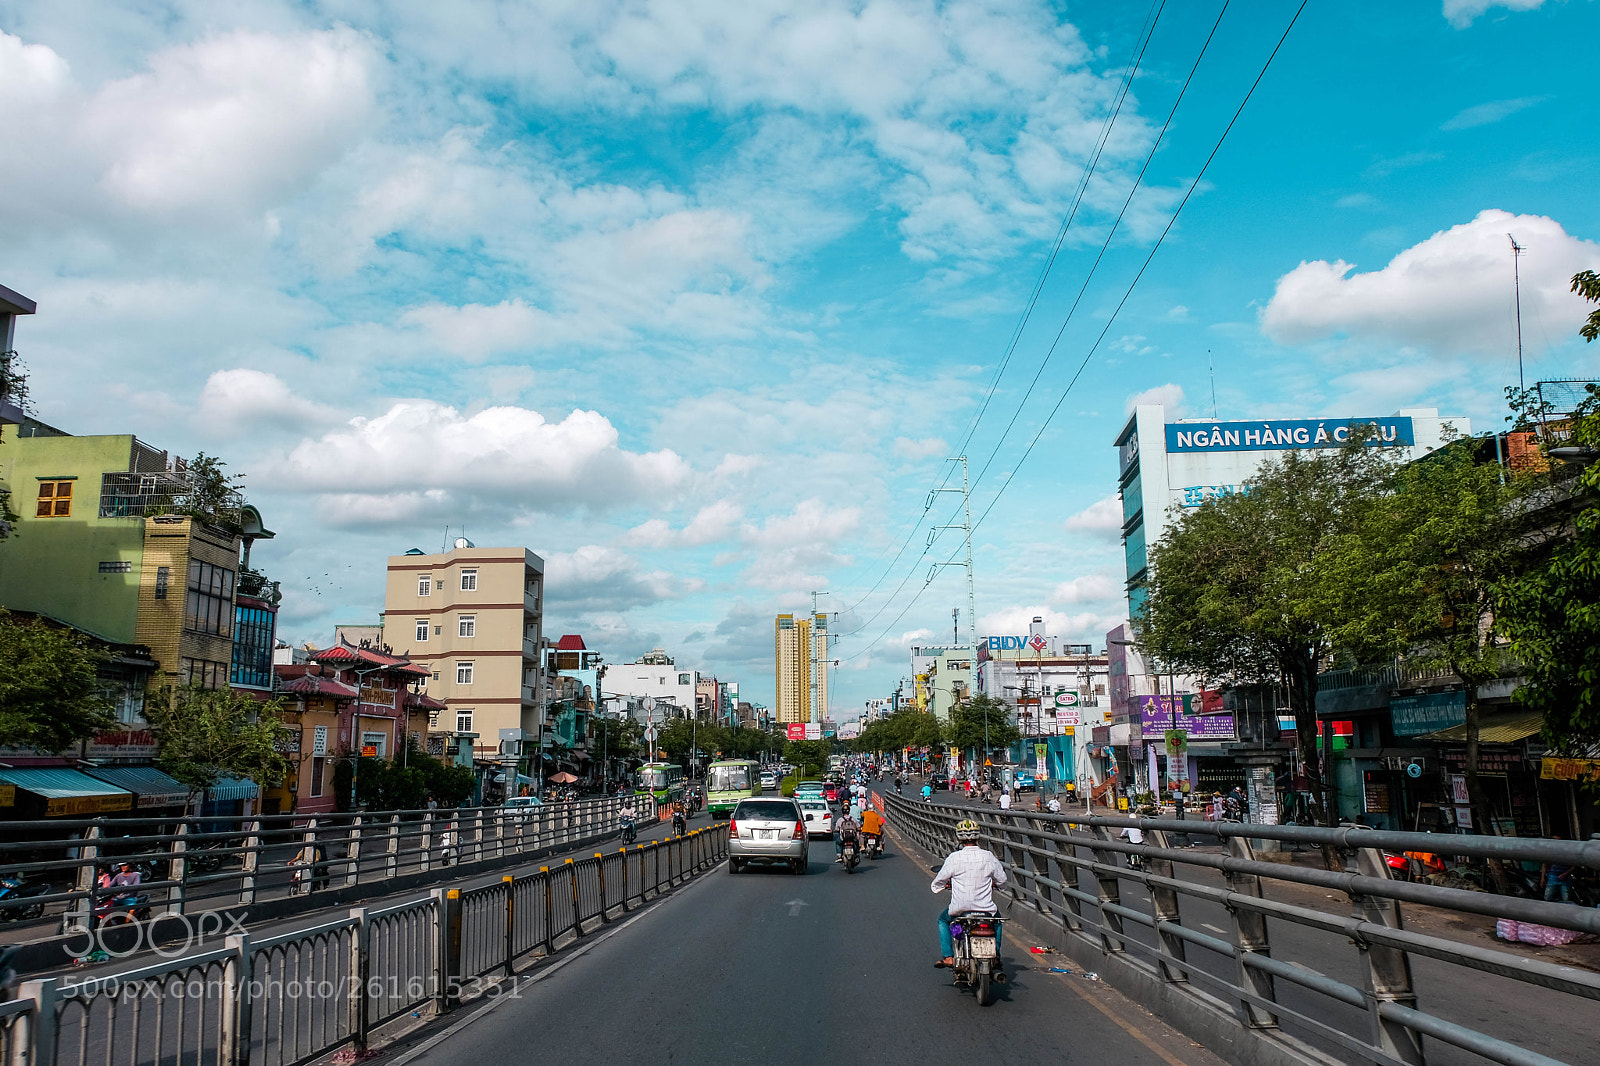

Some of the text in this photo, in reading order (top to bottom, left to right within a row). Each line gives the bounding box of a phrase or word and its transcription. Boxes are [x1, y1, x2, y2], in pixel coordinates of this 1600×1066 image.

[1177, 427, 1240, 448] NGÂN
[1245, 424, 1309, 446] HÀNG
[989, 635, 1029, 651] BIDV
[1059, 695, 1074, 703] SATRA
[1453, 780, 1469, 800] YOGA
